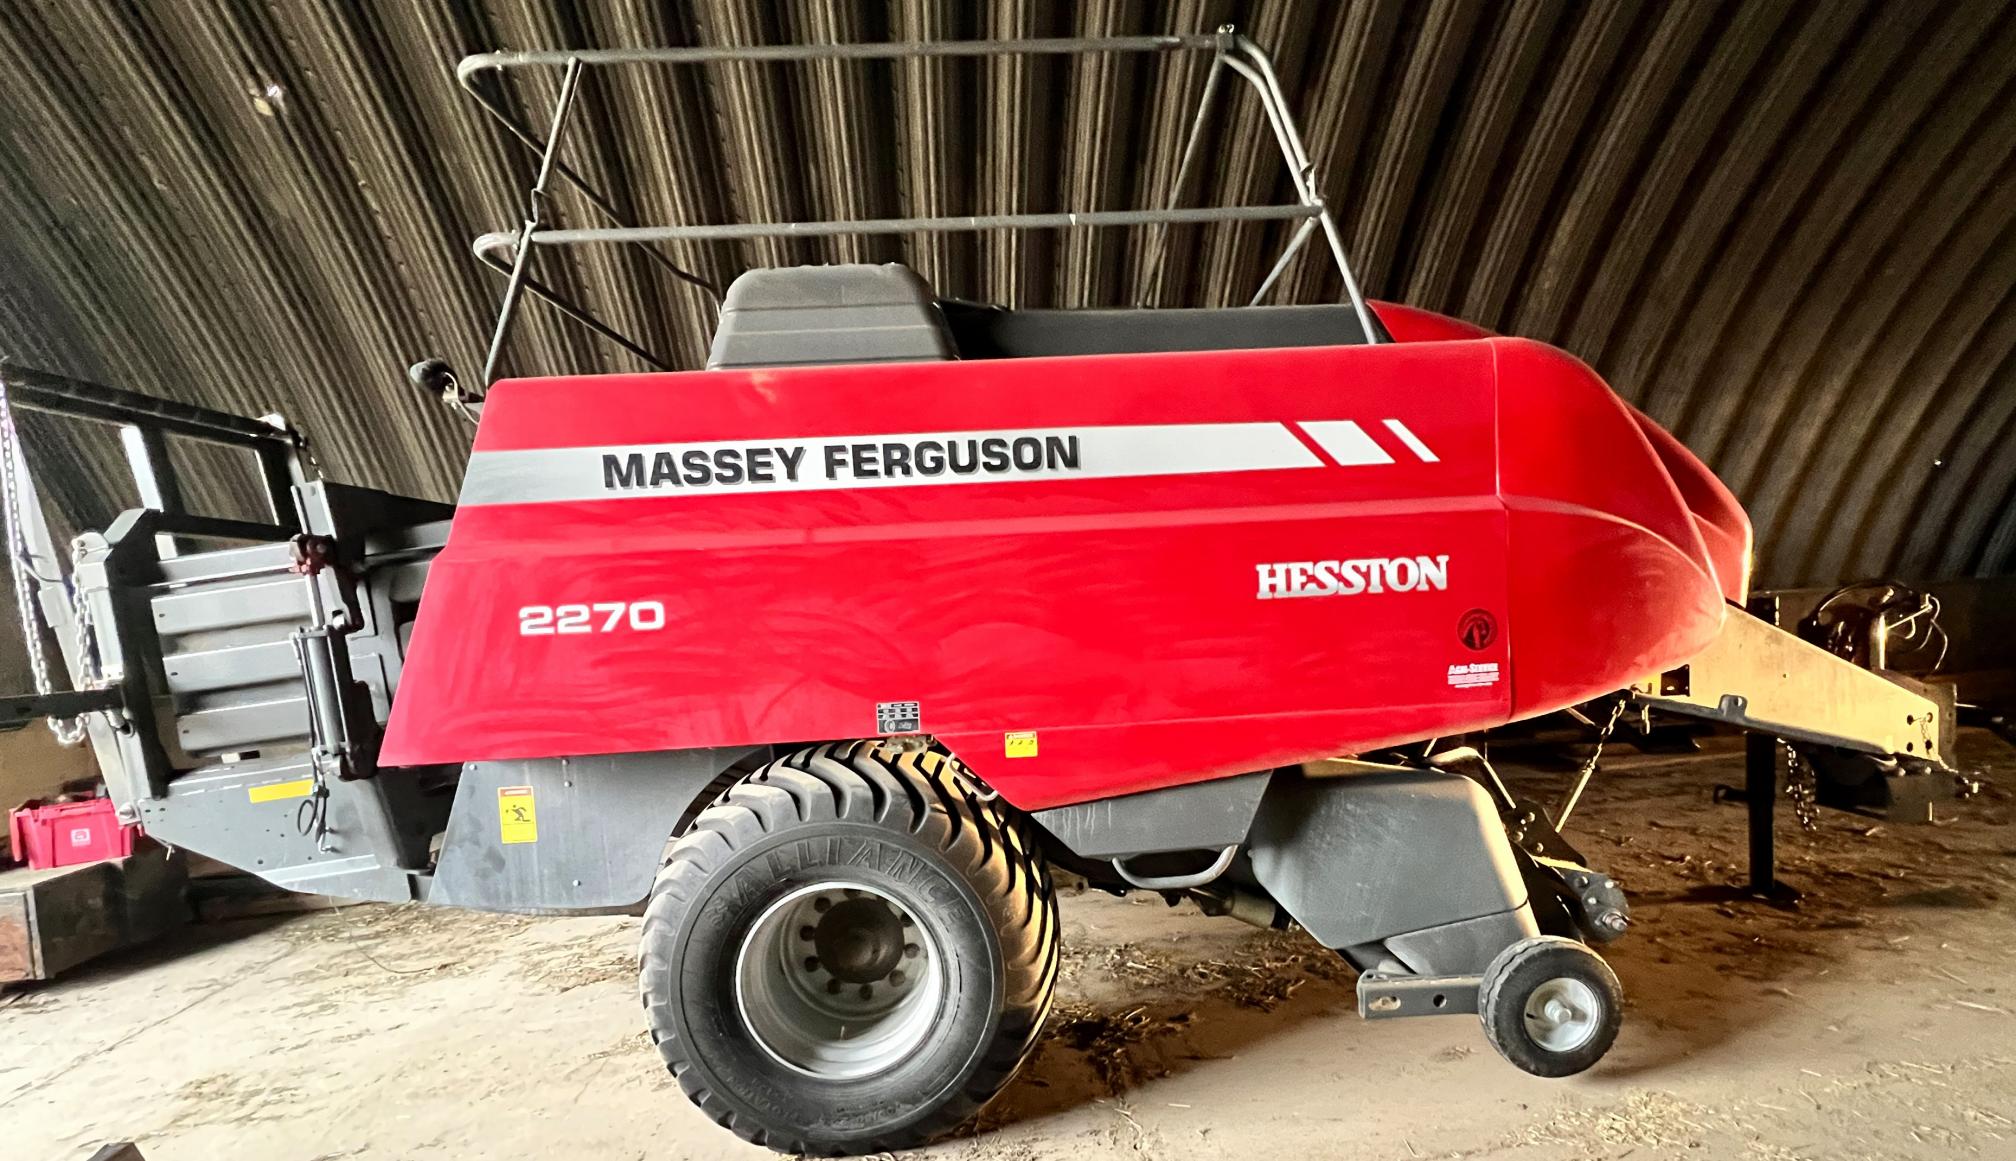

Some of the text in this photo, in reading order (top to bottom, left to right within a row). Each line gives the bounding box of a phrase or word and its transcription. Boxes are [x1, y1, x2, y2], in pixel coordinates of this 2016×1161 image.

[602, 435, 1082, 490] MASSEY FERGUSON
[1255, 554, 1450, 600] HESSTON
[518, 600, 666, 636] 2270
[733, 836, 969, 921] ALLIANCE
